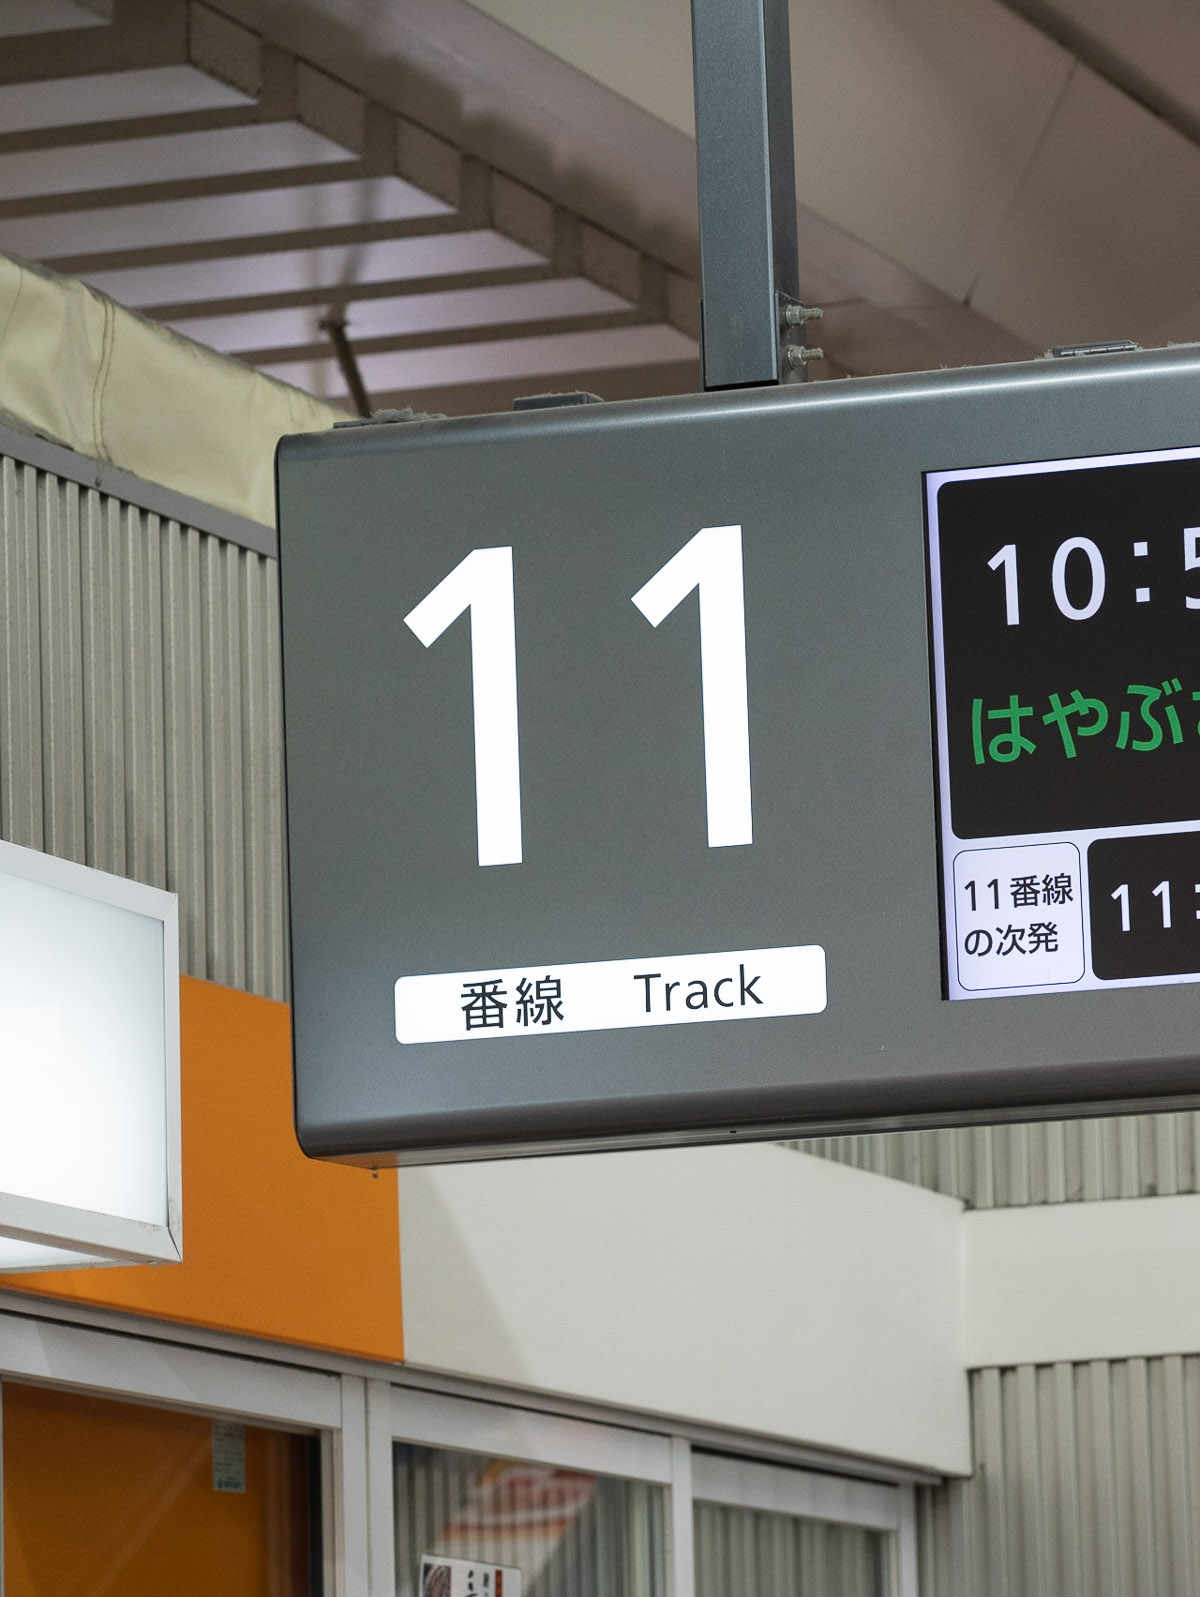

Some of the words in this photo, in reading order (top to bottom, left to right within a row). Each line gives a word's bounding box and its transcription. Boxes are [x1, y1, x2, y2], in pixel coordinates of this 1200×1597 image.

[403, 525, 753, 867] 11
[964, 873, 1074, 910] 11番線
[964, 922, 1059, 956] の次発
[460, 975, 564, 1031] 番線
[633, 964, 764, 1014] Track
